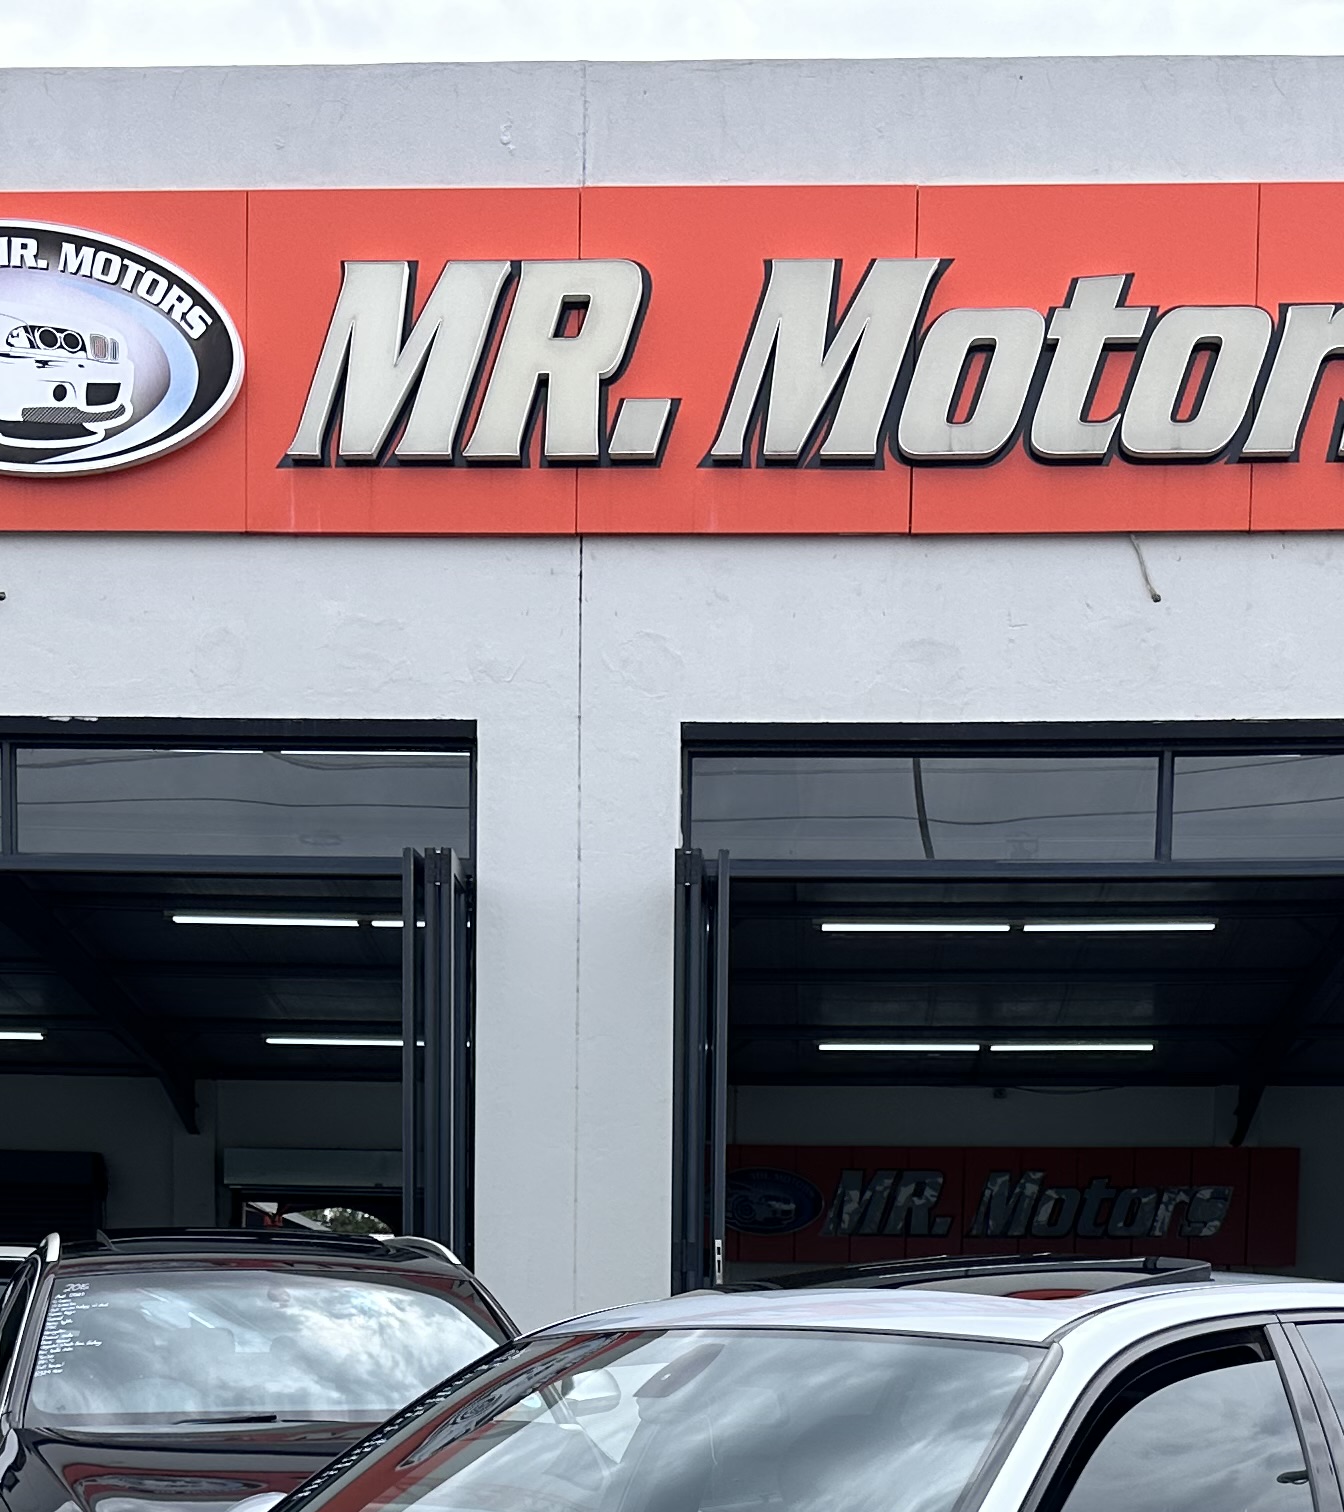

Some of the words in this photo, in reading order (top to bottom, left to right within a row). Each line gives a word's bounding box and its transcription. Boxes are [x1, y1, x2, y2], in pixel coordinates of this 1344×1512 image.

[58, 242, 213, 340] MOTORS
[283, 258, 676, 464] MR.
[820, 1167, 952, 1237] MR.
[965, 1168, 1234, 1239] Motors
